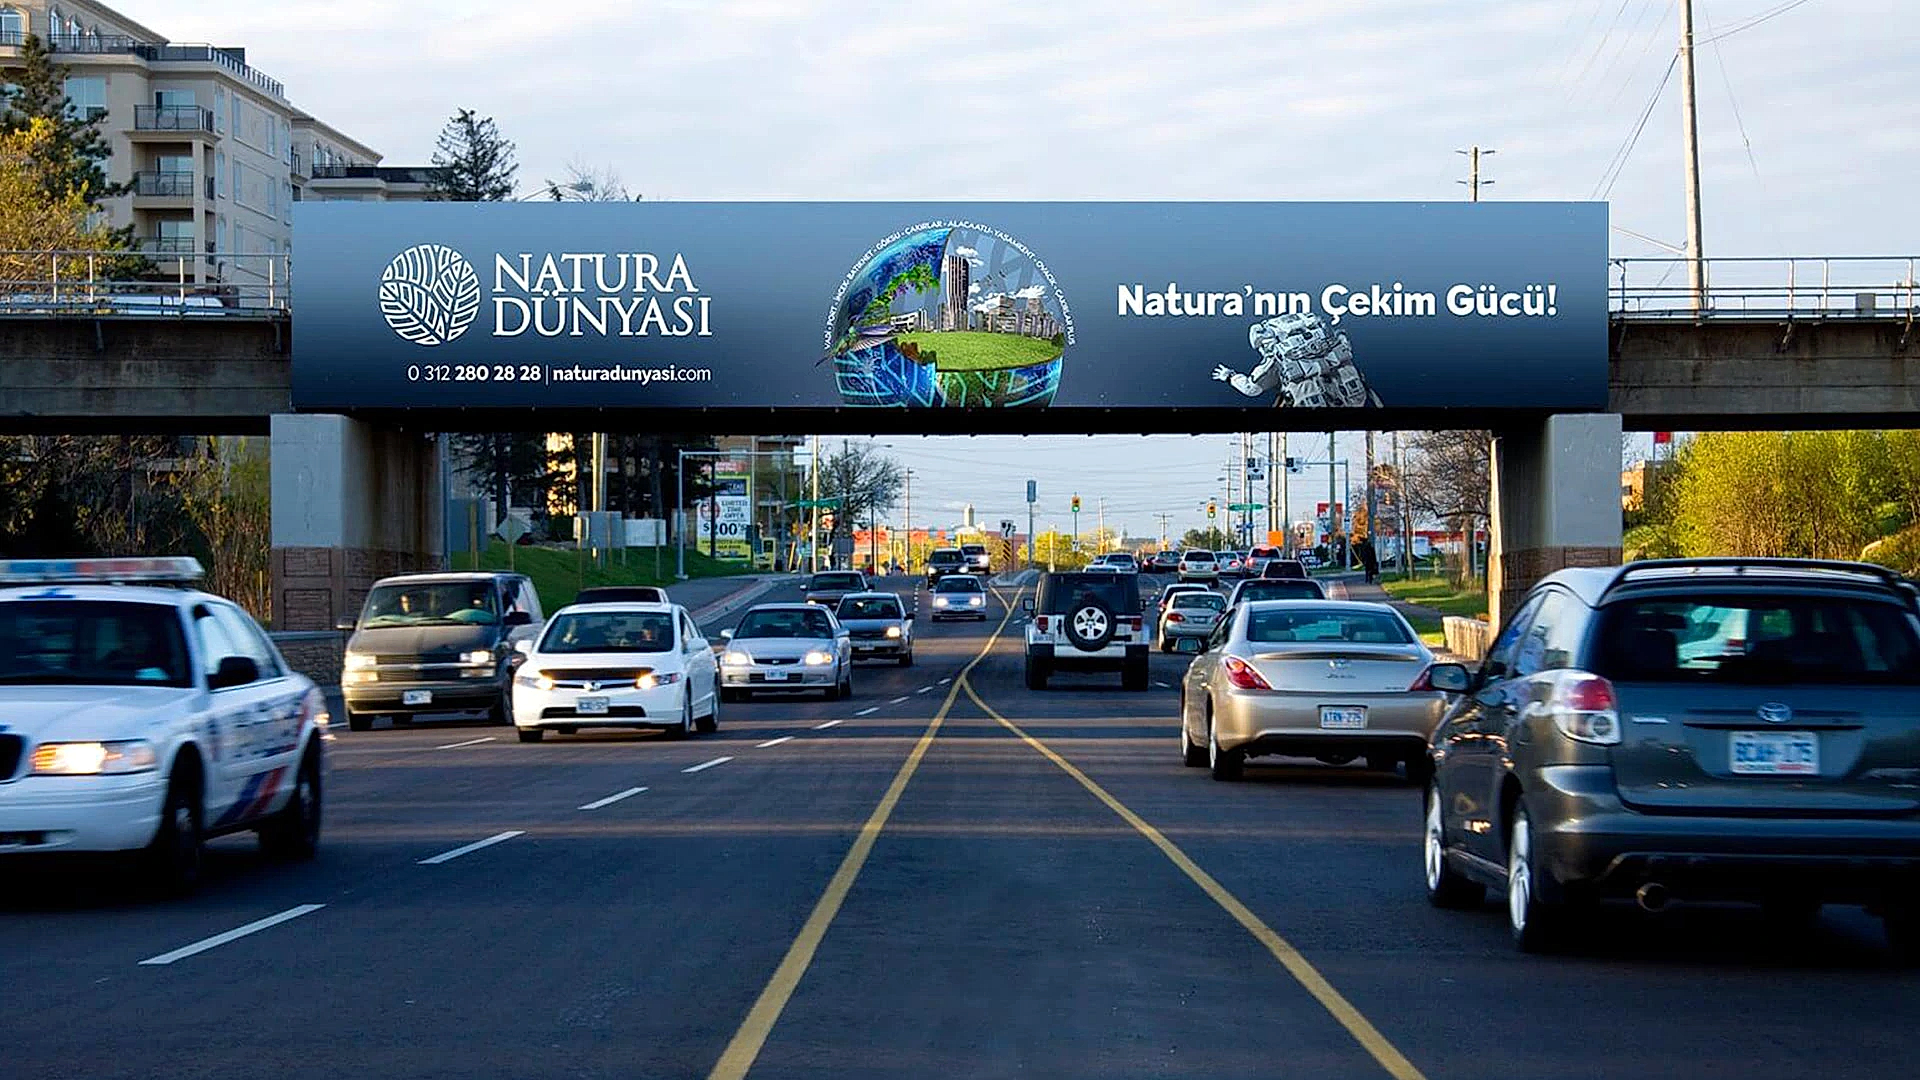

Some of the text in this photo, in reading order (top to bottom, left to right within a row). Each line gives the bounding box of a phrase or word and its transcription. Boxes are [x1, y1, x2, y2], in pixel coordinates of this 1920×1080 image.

[492, 252, 699, 293] NATURA
[492, 288, 712, 337] DÜNYASI
[1321, 282, 1436, 325] Çekim
[1446, 284, 1557, 316] Gücü!
[407, 364, 711, 386] 0 312 280 28 28 naturadunyasi.com
